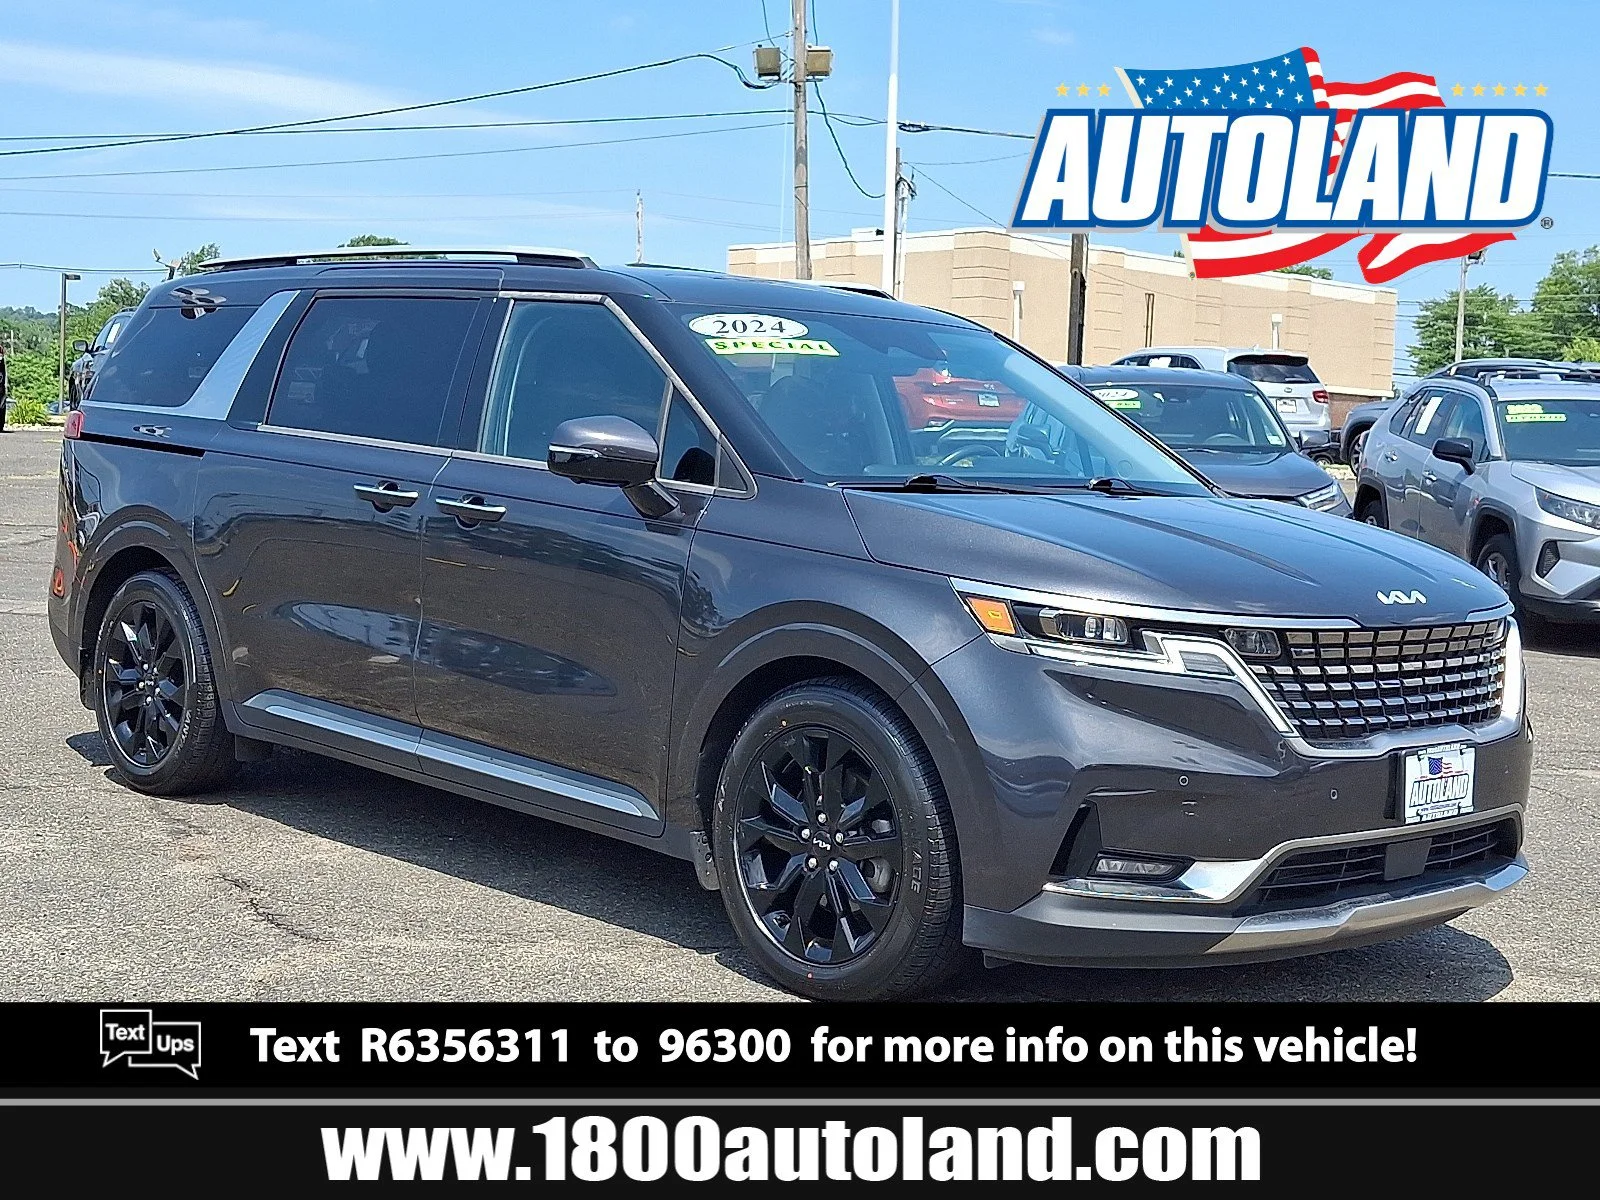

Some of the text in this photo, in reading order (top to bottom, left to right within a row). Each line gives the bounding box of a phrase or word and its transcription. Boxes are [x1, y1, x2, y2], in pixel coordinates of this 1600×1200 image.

[713, 319, 786, 335] 2024
[714, 340, 831, 351] SPECIAL
[1409, 773, 1469, 808] AUTOLAND
